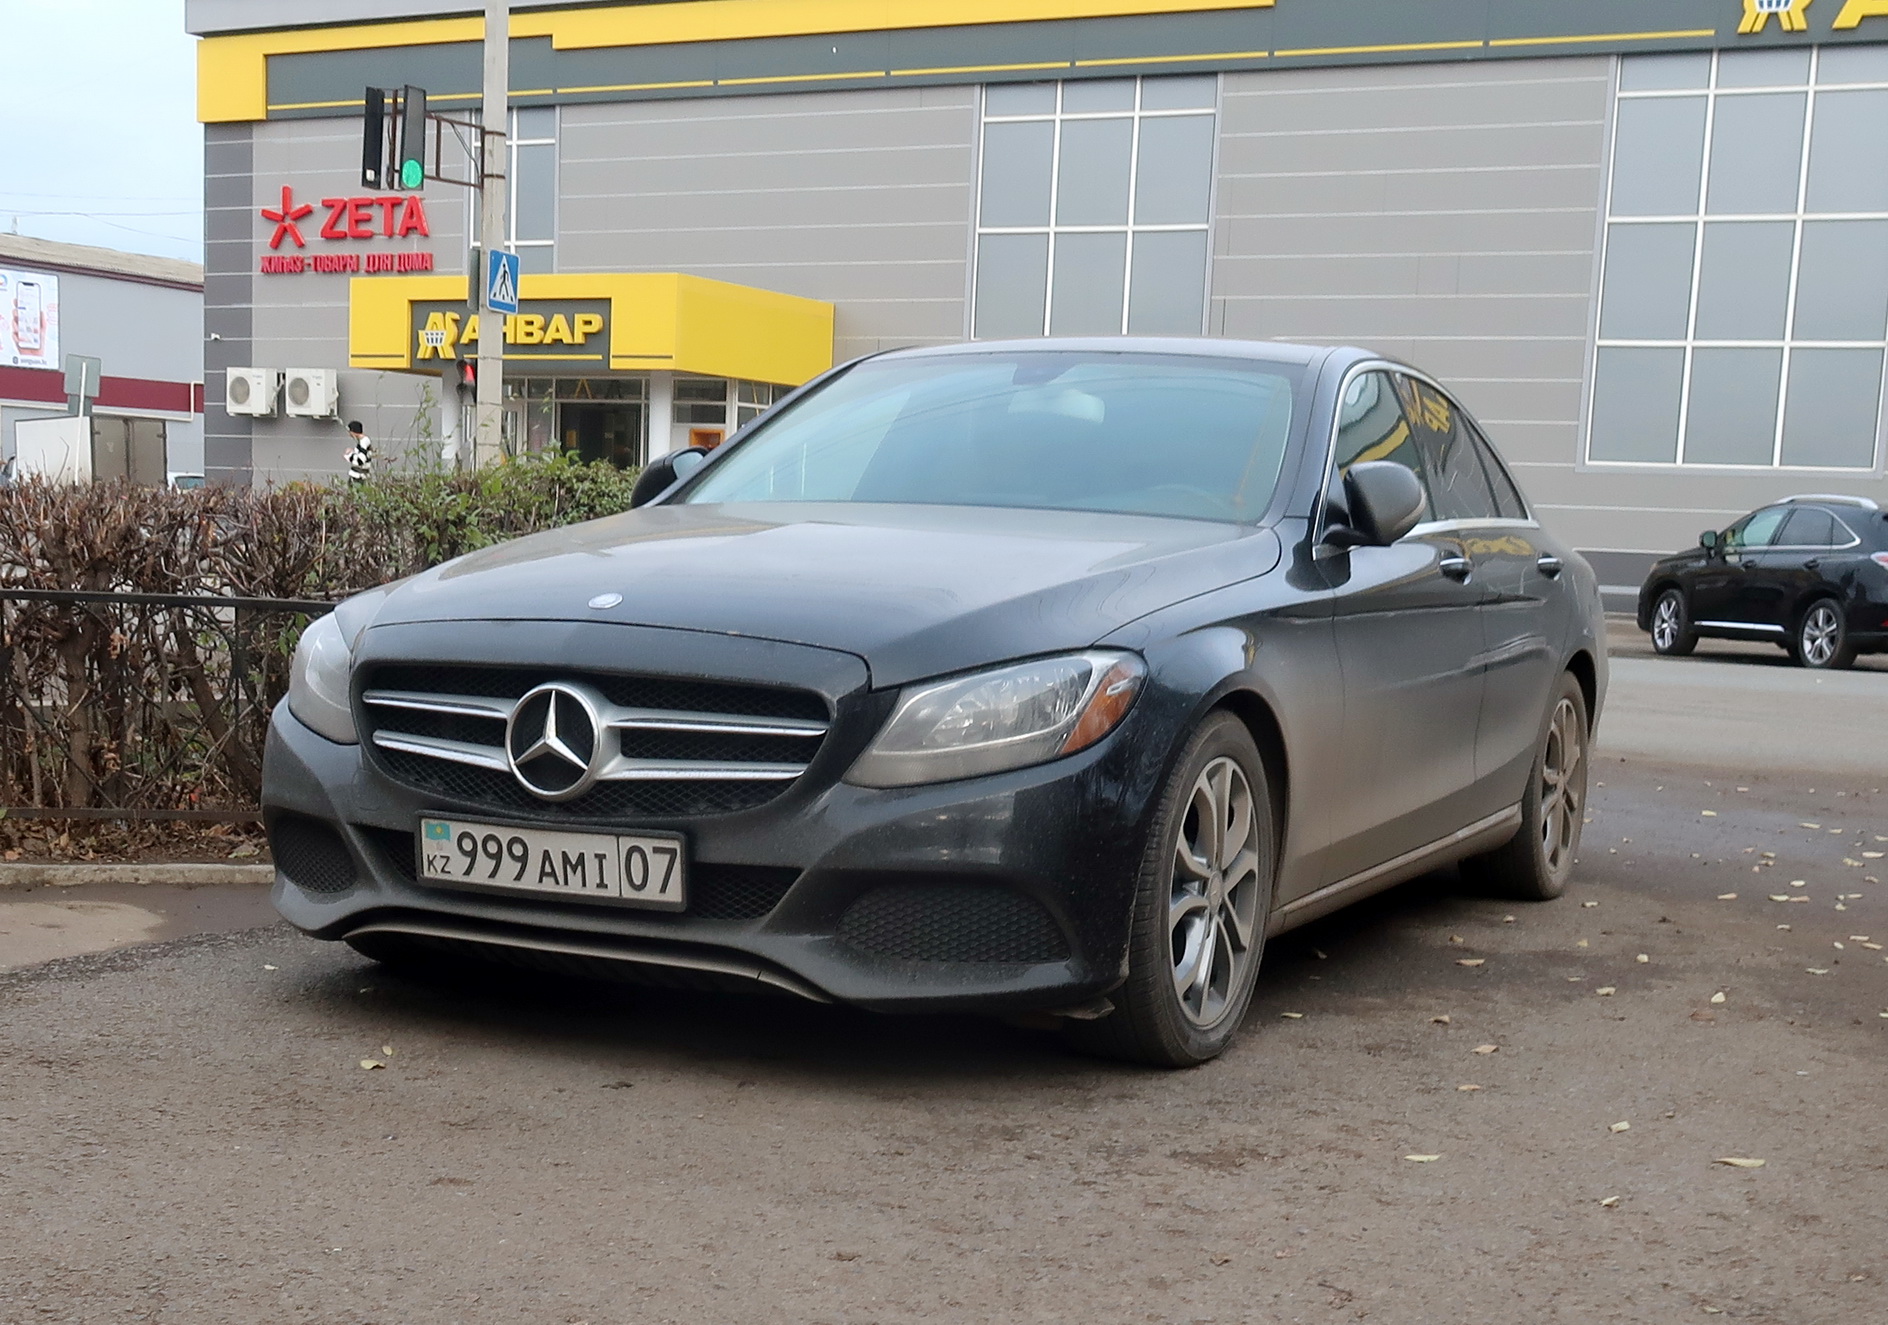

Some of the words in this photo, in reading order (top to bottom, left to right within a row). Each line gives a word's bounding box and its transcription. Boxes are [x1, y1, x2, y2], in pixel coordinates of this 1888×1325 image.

[320, 195, 430, 240] ZETA
[364, 253, 394, 273] ДЛЯ
[396, 252, 433, 273] ДОМА
[426, 853, 452, 875] KZ
[624, 845, 678, 894] 07
